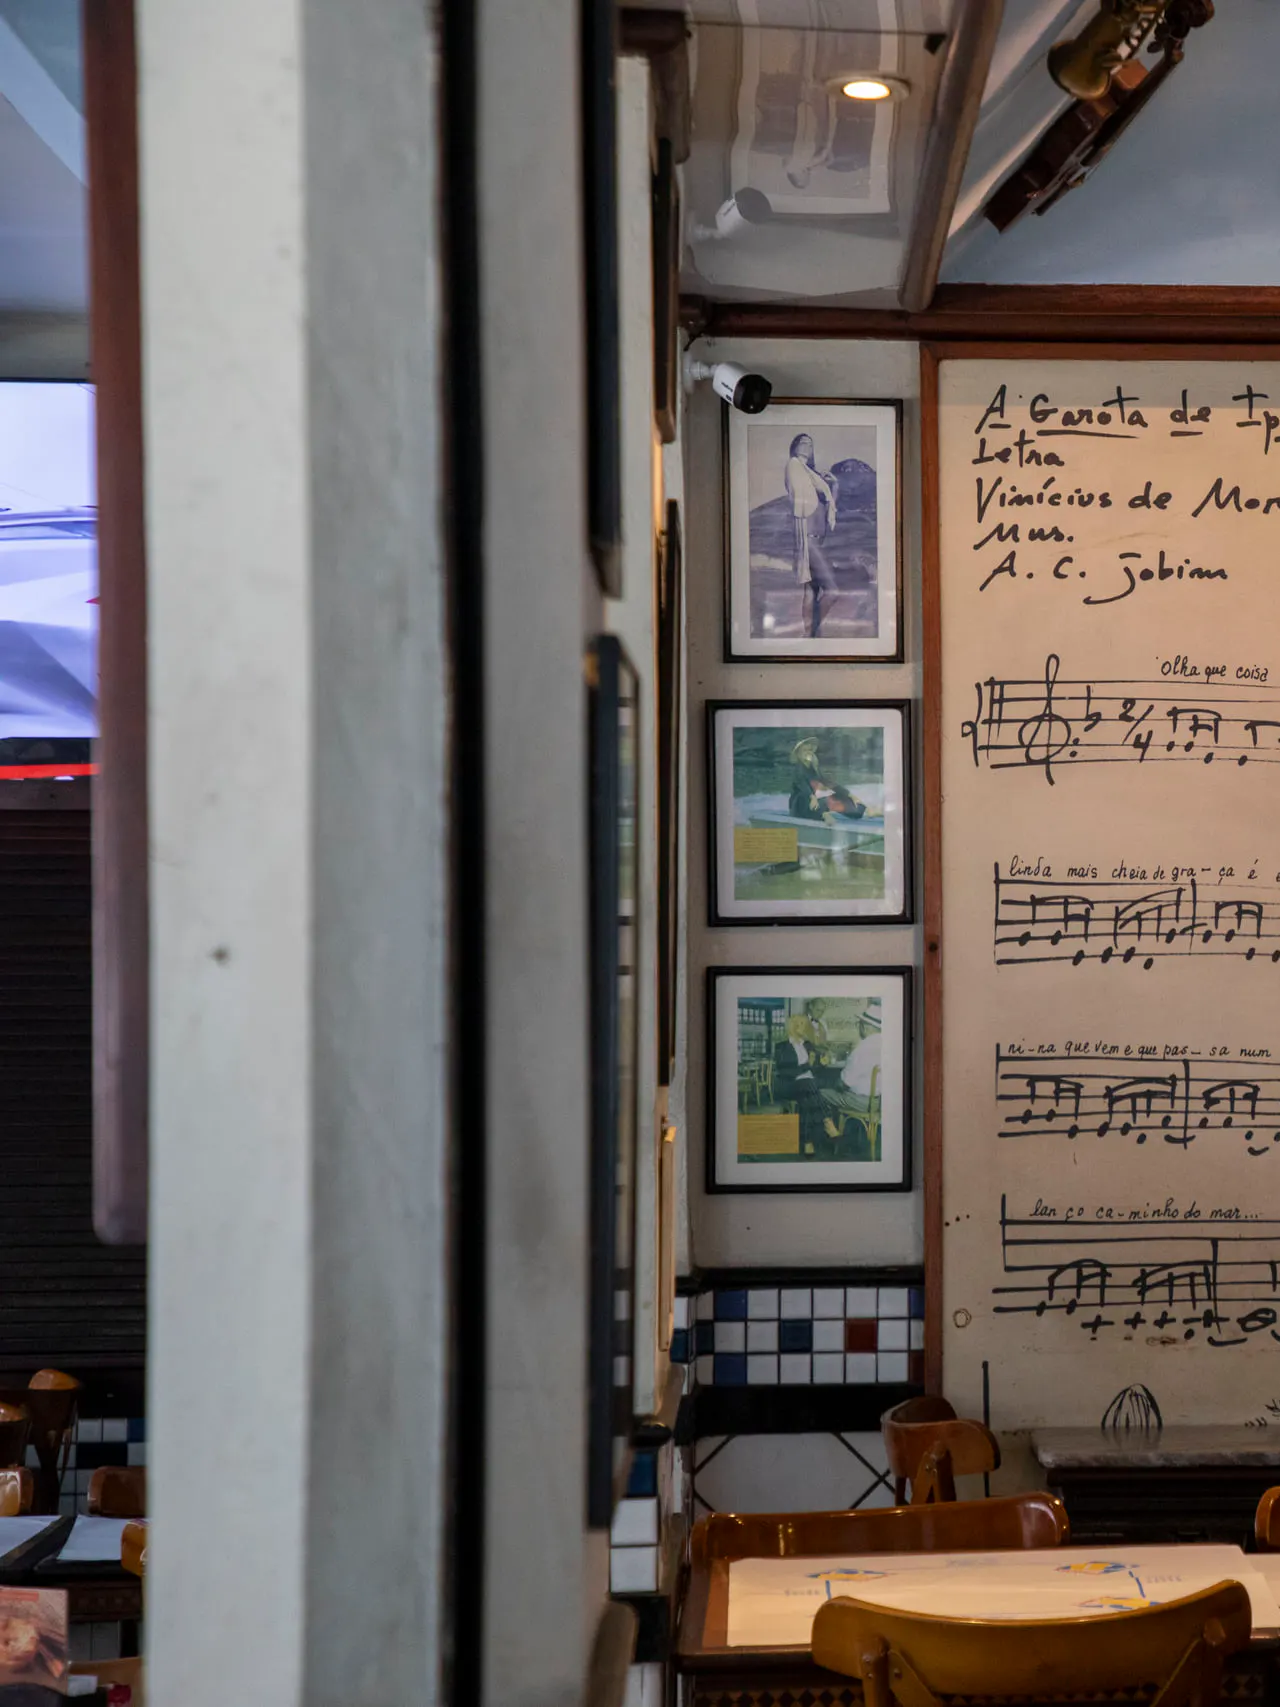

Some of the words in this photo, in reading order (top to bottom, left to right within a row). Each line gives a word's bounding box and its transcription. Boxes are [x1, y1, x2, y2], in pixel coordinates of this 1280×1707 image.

[1030, 386, 1148, 428] Garota
[1170, 389, 1211, 423] de
[972, 429, 1064, 467] Letra
[976, 476, 1112, 523] Vinícius
[1127, 481, 1172, 509] de
[973, 522, 1074, 550] Mus.
[980, 550, 1033, 591] A.
[1053, 556, 1086, 579] C.
[1205, 664, 1227, 684] que
[1236, 664, 1268, 682] coisa
[1009, 855, 1052, 877] linda
[1067, 863, 1098, 879] mais
[1111, 860, 1148, 880] cheia
[1153, 867, 1166, 880] de
[1247, 859, 1259, 880] é
[1064, 1040, 1090, 1057] que
[1094, 1040, 1120, 1055] vem
[1124, 1045, 1133, 1056] e
[1138, 1044, 1158, 1060] que
[1239, 1047, 1272, 1058] num
[1183, 1200, 1202, 1219] do
